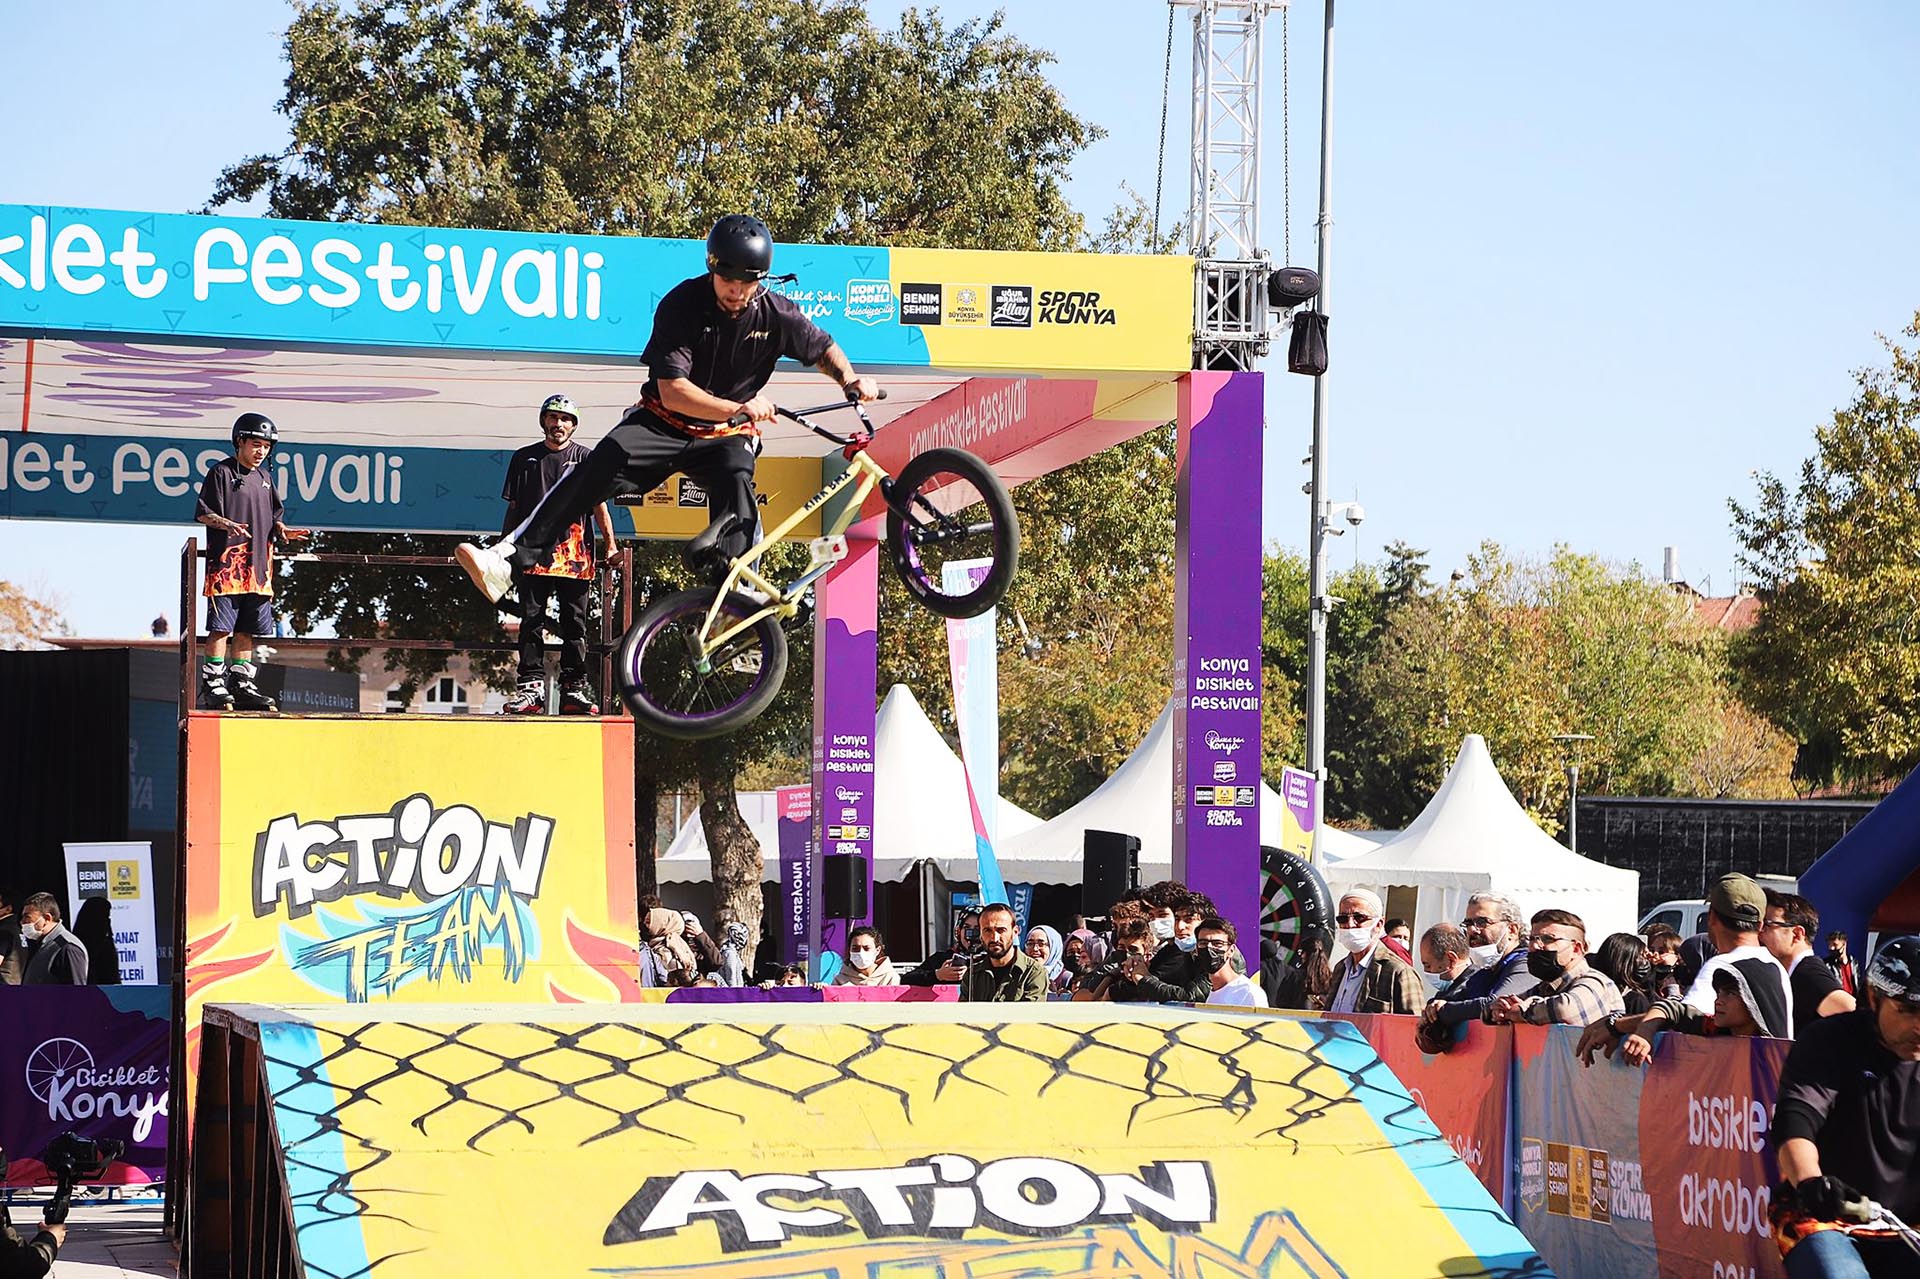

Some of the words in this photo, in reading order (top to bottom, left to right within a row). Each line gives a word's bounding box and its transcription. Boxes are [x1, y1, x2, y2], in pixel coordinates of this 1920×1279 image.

[193, 227, 605, 321] festivali
[850, 284, 890, 294] KONYA
[1038, 291, 1100, 311] SPOR
[1039, 301, 1116, 325] KONYA
[979, 378, 1028, 441] festivali
[112, 443, 404, 503] fesivali
[1200, 657, 1249, 675] konya
[1196, 676, 1255, 692] bisiklet
[1191, 696, 1259, 711] festivali
[833, 735, 868, 748] konya
[826, 761, 874, 773] festivali
[1265, 854, 1272, 864] 1
[1280, 862, 1293, 876] 18
[1304, 898, 1315, 912] 13
[111, 932, 140, 944] ANAT
[293, 880, 525, 1002] TEAM
[77, 1065, 160, 1087] Bisiklet
[1689, 1091, 1777, 1154] bisikle
[1610, 1161, 1642, 1190] SPOR
[605, 1154, 1217, 1250] ACTION
[1611, 1180, 1653, 1222] KONYA
